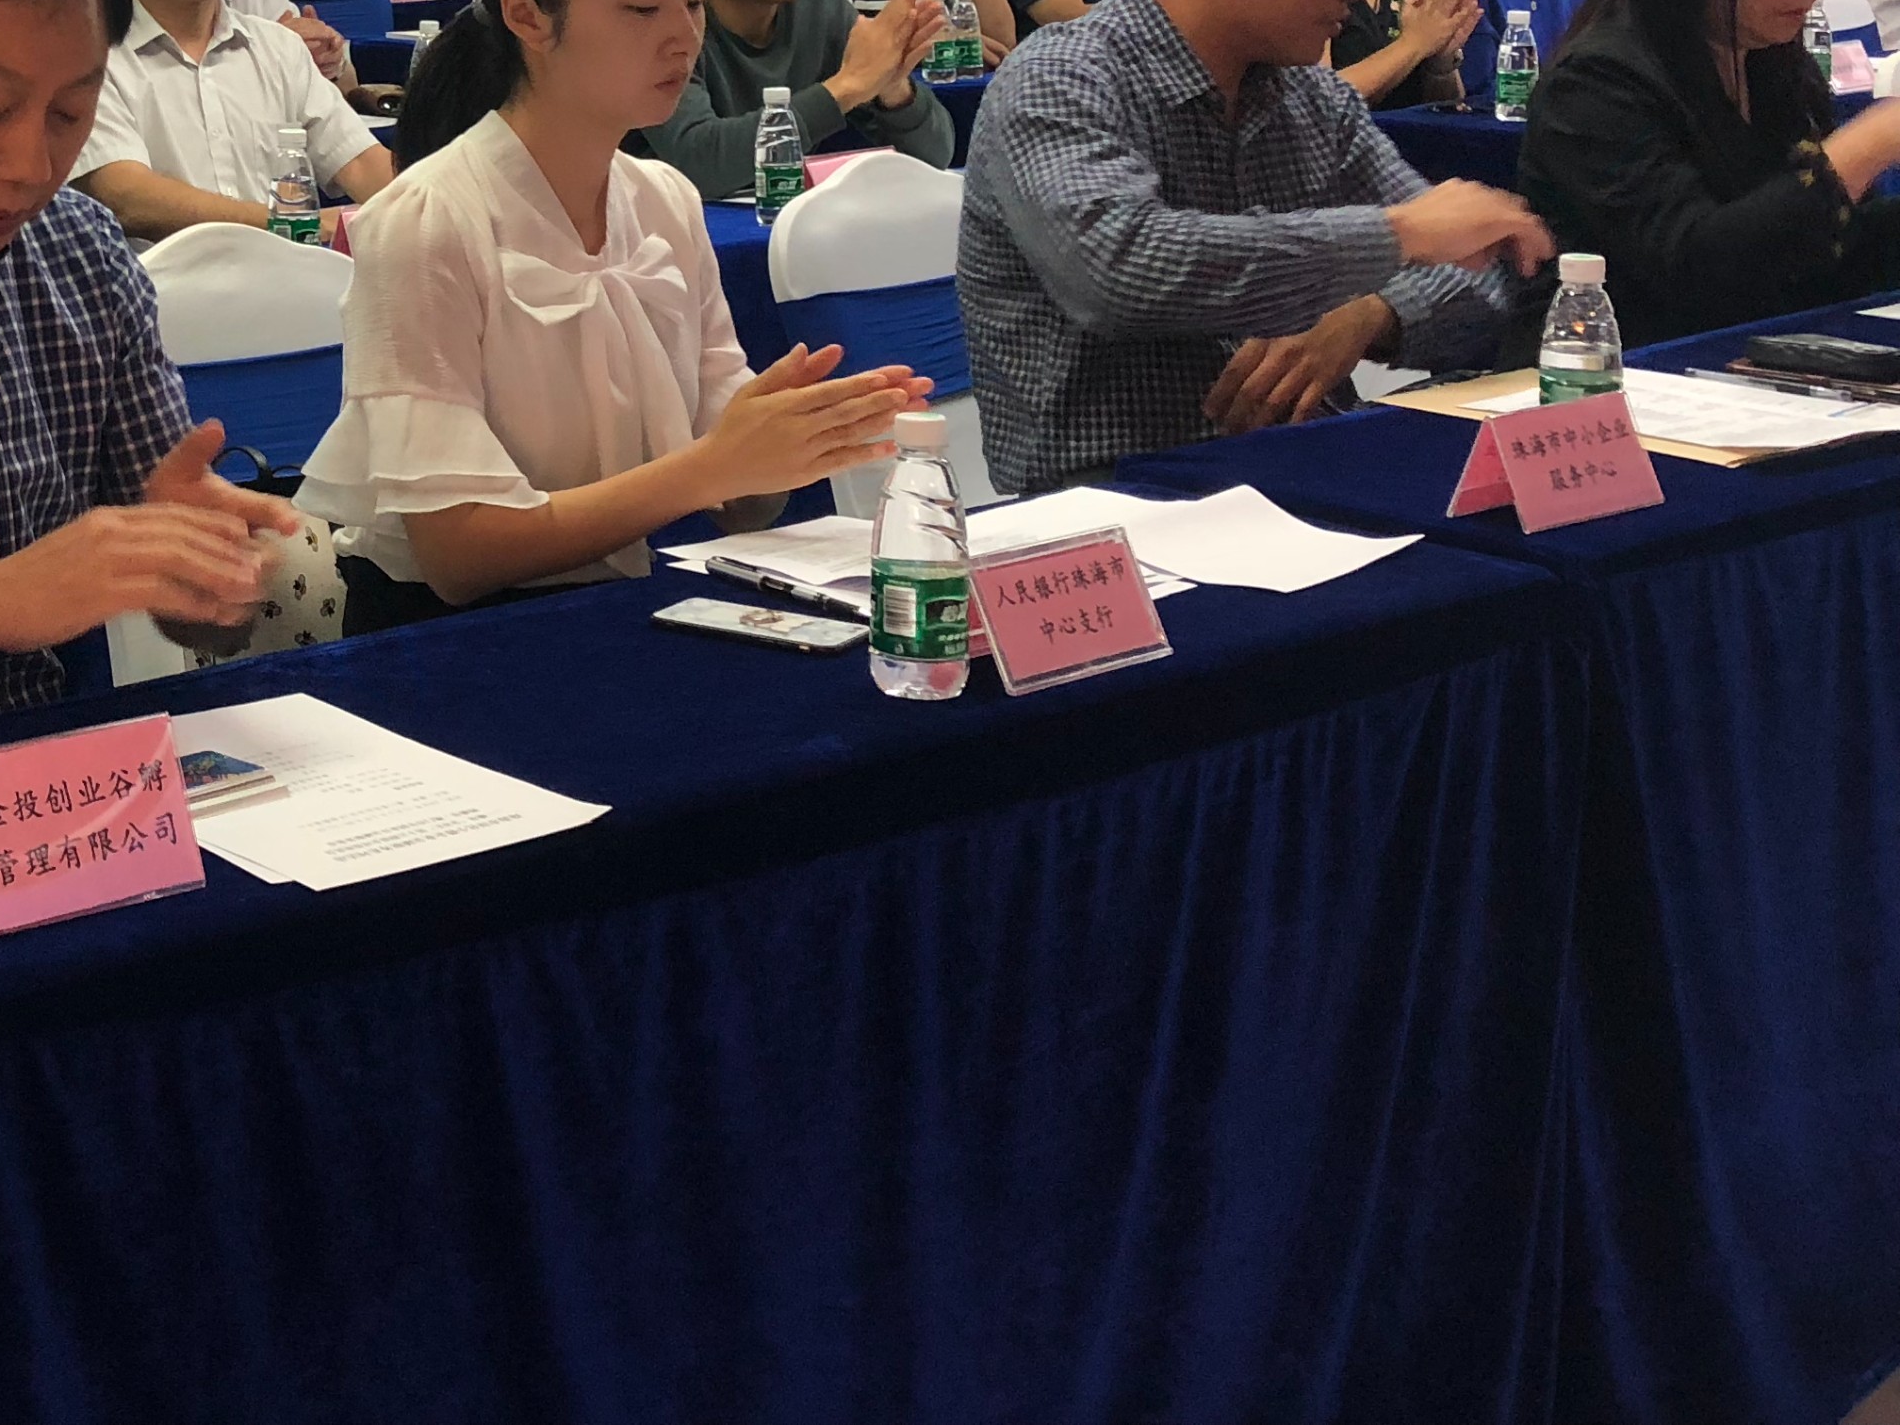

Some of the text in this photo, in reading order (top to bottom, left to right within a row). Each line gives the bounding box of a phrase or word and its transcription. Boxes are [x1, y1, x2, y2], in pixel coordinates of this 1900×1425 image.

[1511, 417, 1630, 460] 珠海市中小企业
[1549, 460, 1618, 491] 服务中心
[997, 555, 1126, 609] 人民银行珠海市
[1039, 603, 1114, 645] 中心支行
